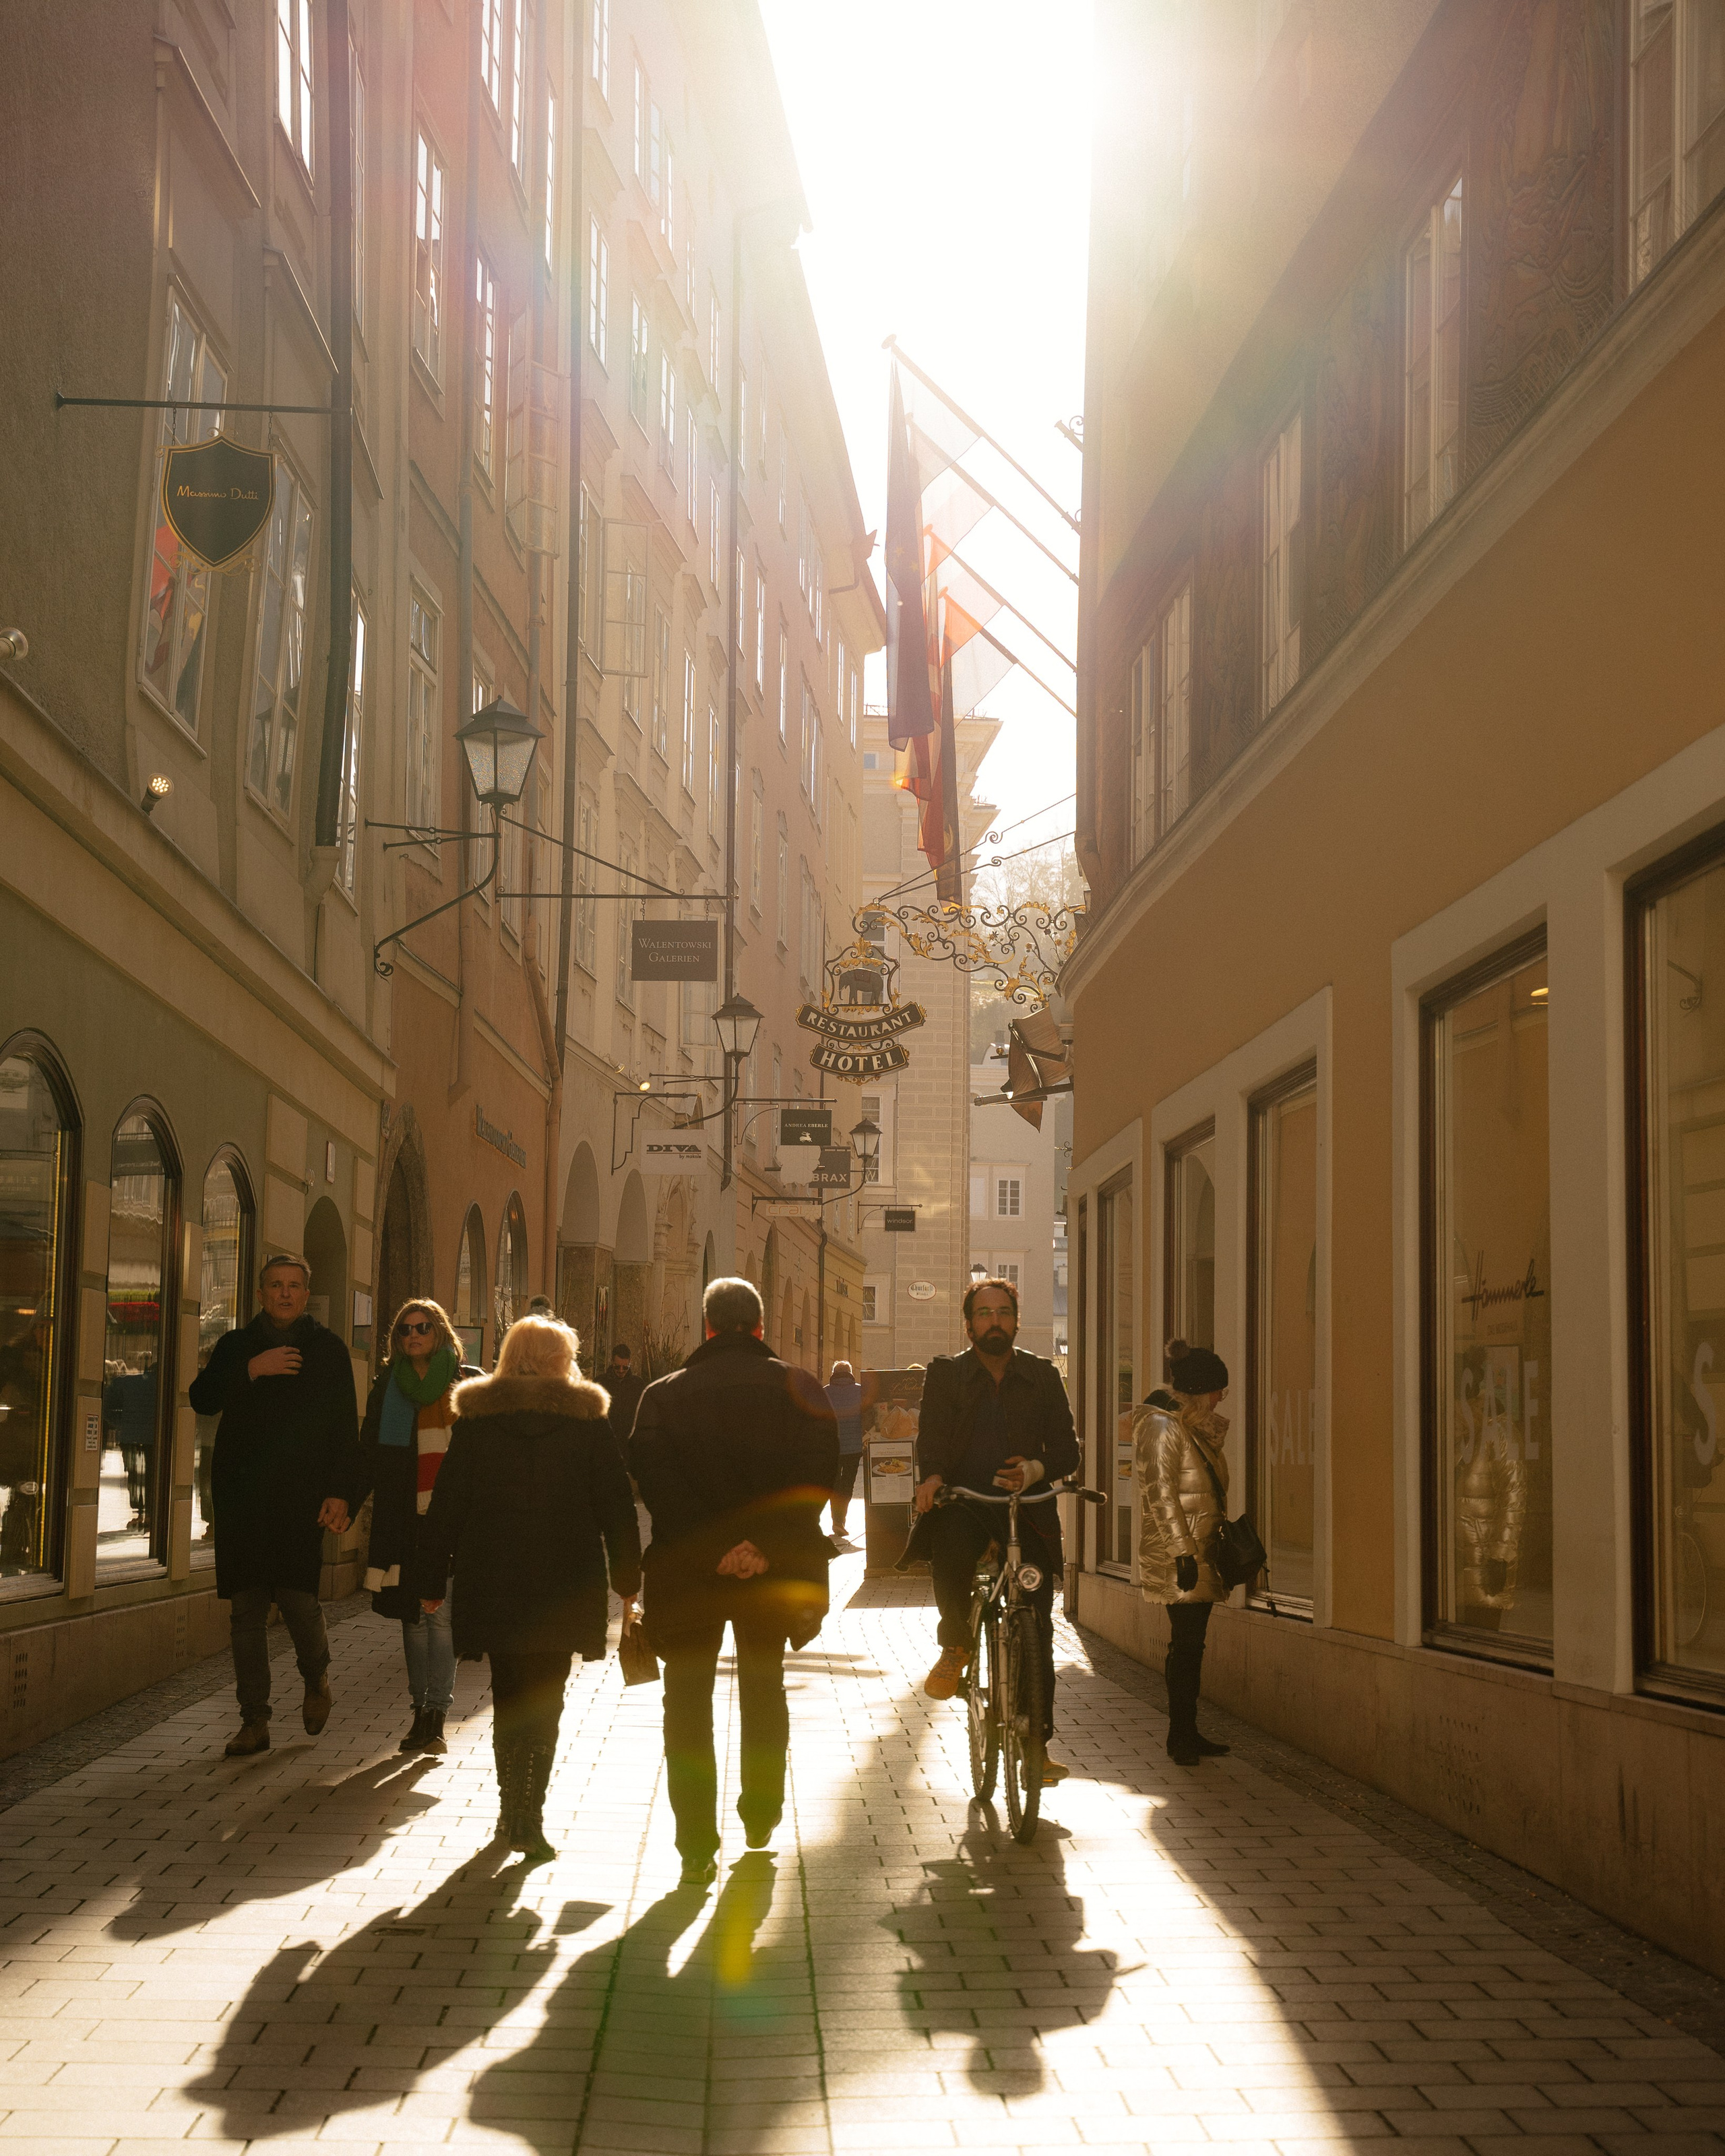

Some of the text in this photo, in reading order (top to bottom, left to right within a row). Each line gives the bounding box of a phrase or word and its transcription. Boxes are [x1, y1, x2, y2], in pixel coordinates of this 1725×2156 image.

[177, 485, 259, 500] Massimo Dutti
[638, 938, 712, 949] WALENTOWSKI
[649, 951, 699, 962] GALERIEN
[807, 1011, 912, 1038] RESTAURANT
[819, 1050, 898, 1072] HOTEL
[646, 1144, 701, 1152] DIVA
[813, 1173, 847, 1182] BRAX
[1460, 1360, 1540, 1465] SALE
